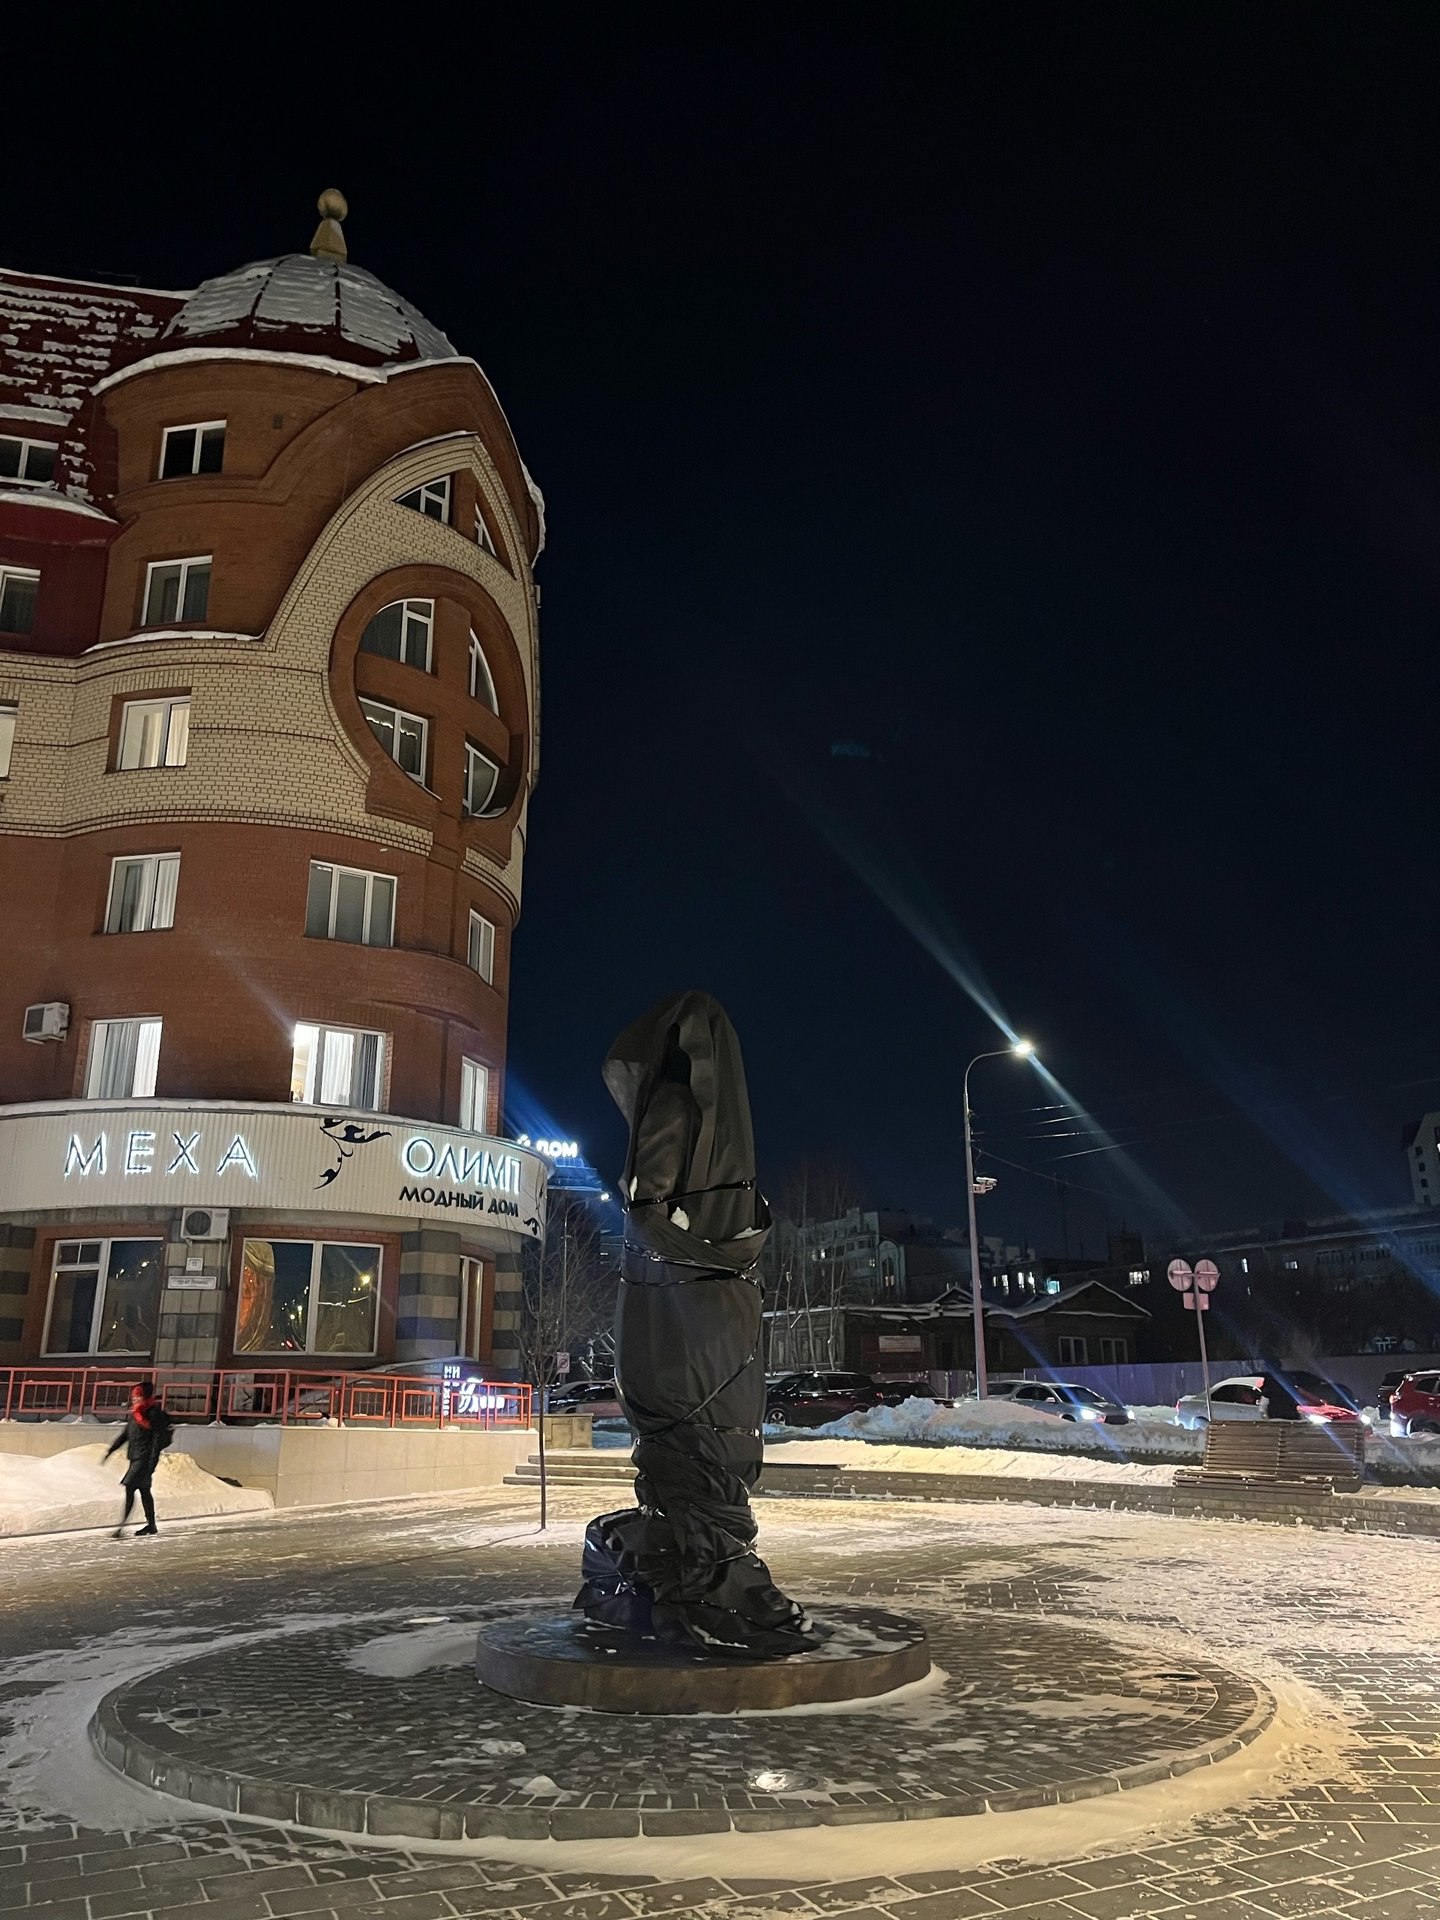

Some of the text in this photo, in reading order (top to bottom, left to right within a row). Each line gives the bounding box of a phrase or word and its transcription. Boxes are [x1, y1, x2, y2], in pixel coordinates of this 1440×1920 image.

[64, 1131, 258, 1179] МЕХА
[402, 1136, 523, 1195] ОЛИМП
[399, 1186, 520, 1217] МОДНЫЙ ДОМ
